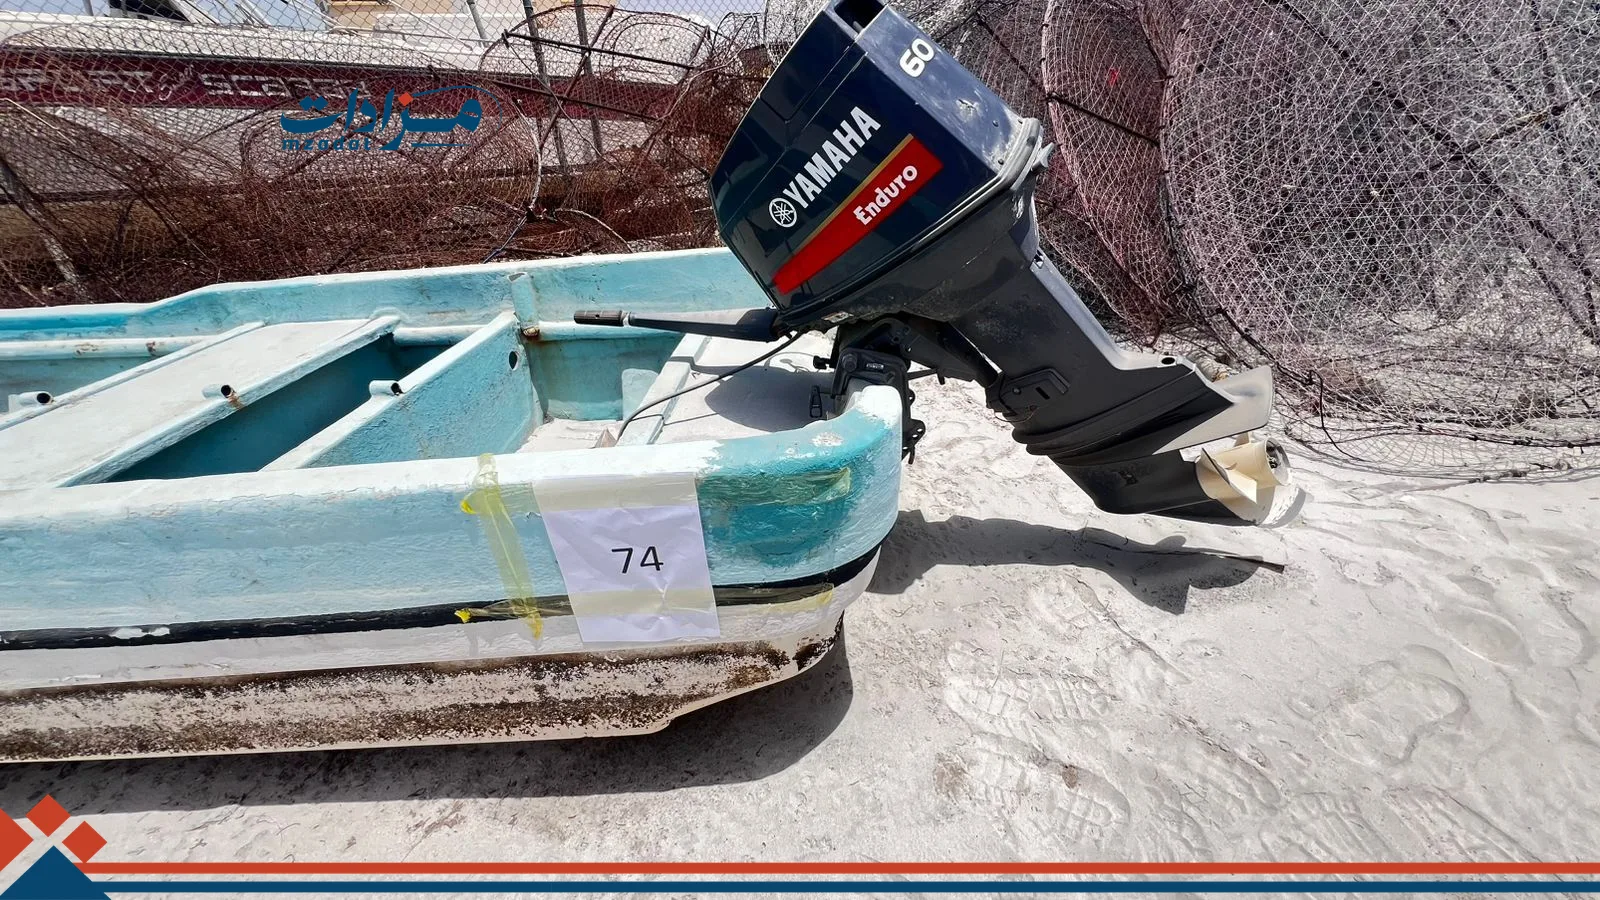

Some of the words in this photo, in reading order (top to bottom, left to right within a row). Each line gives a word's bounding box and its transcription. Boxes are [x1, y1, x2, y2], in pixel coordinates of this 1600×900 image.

[899, 38, 935, 78] 60
[783, 105, 881, 209] YAMAHA
[852, 164, 918, 225] Enduro
[611, 545, 664, 574] 74
